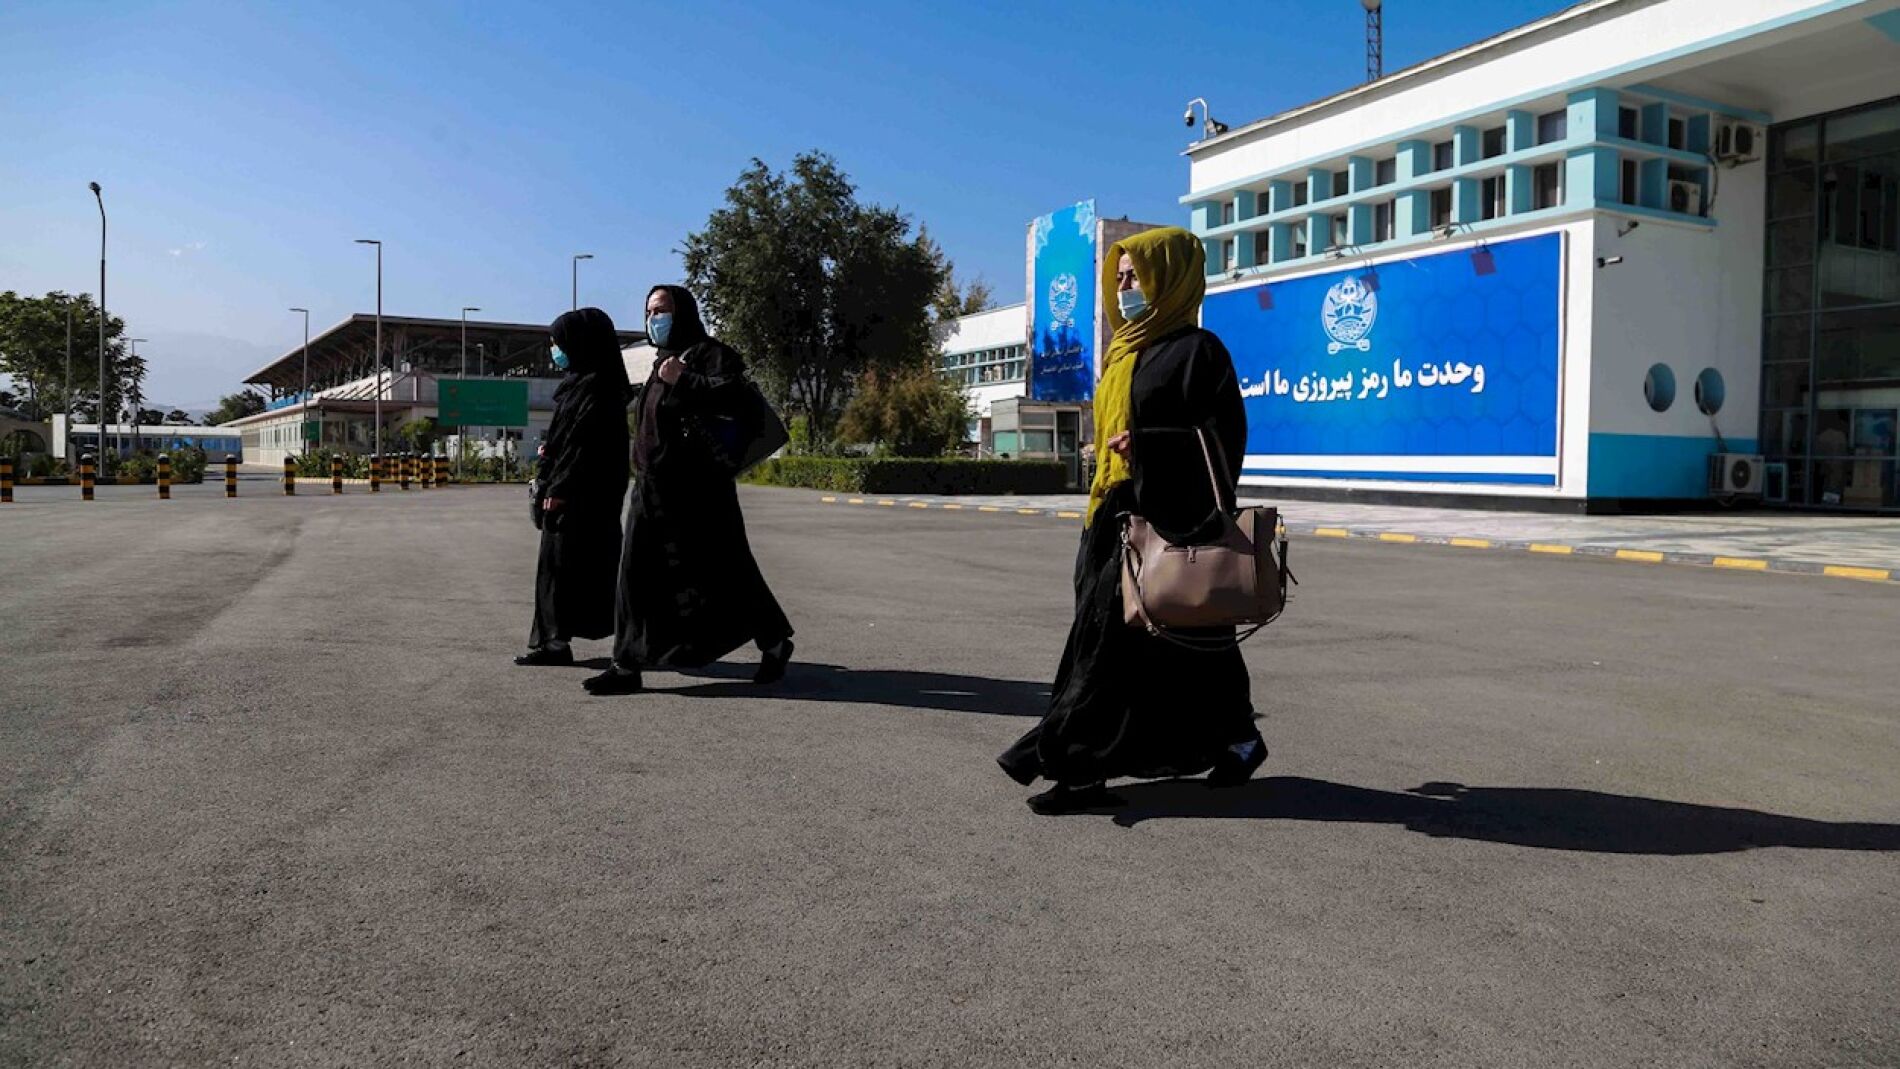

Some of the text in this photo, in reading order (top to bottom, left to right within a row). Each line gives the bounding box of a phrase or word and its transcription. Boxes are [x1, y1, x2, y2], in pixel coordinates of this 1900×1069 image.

[1238, 358, 1485, 401] وحدت ما رمز پیروزی ما است
